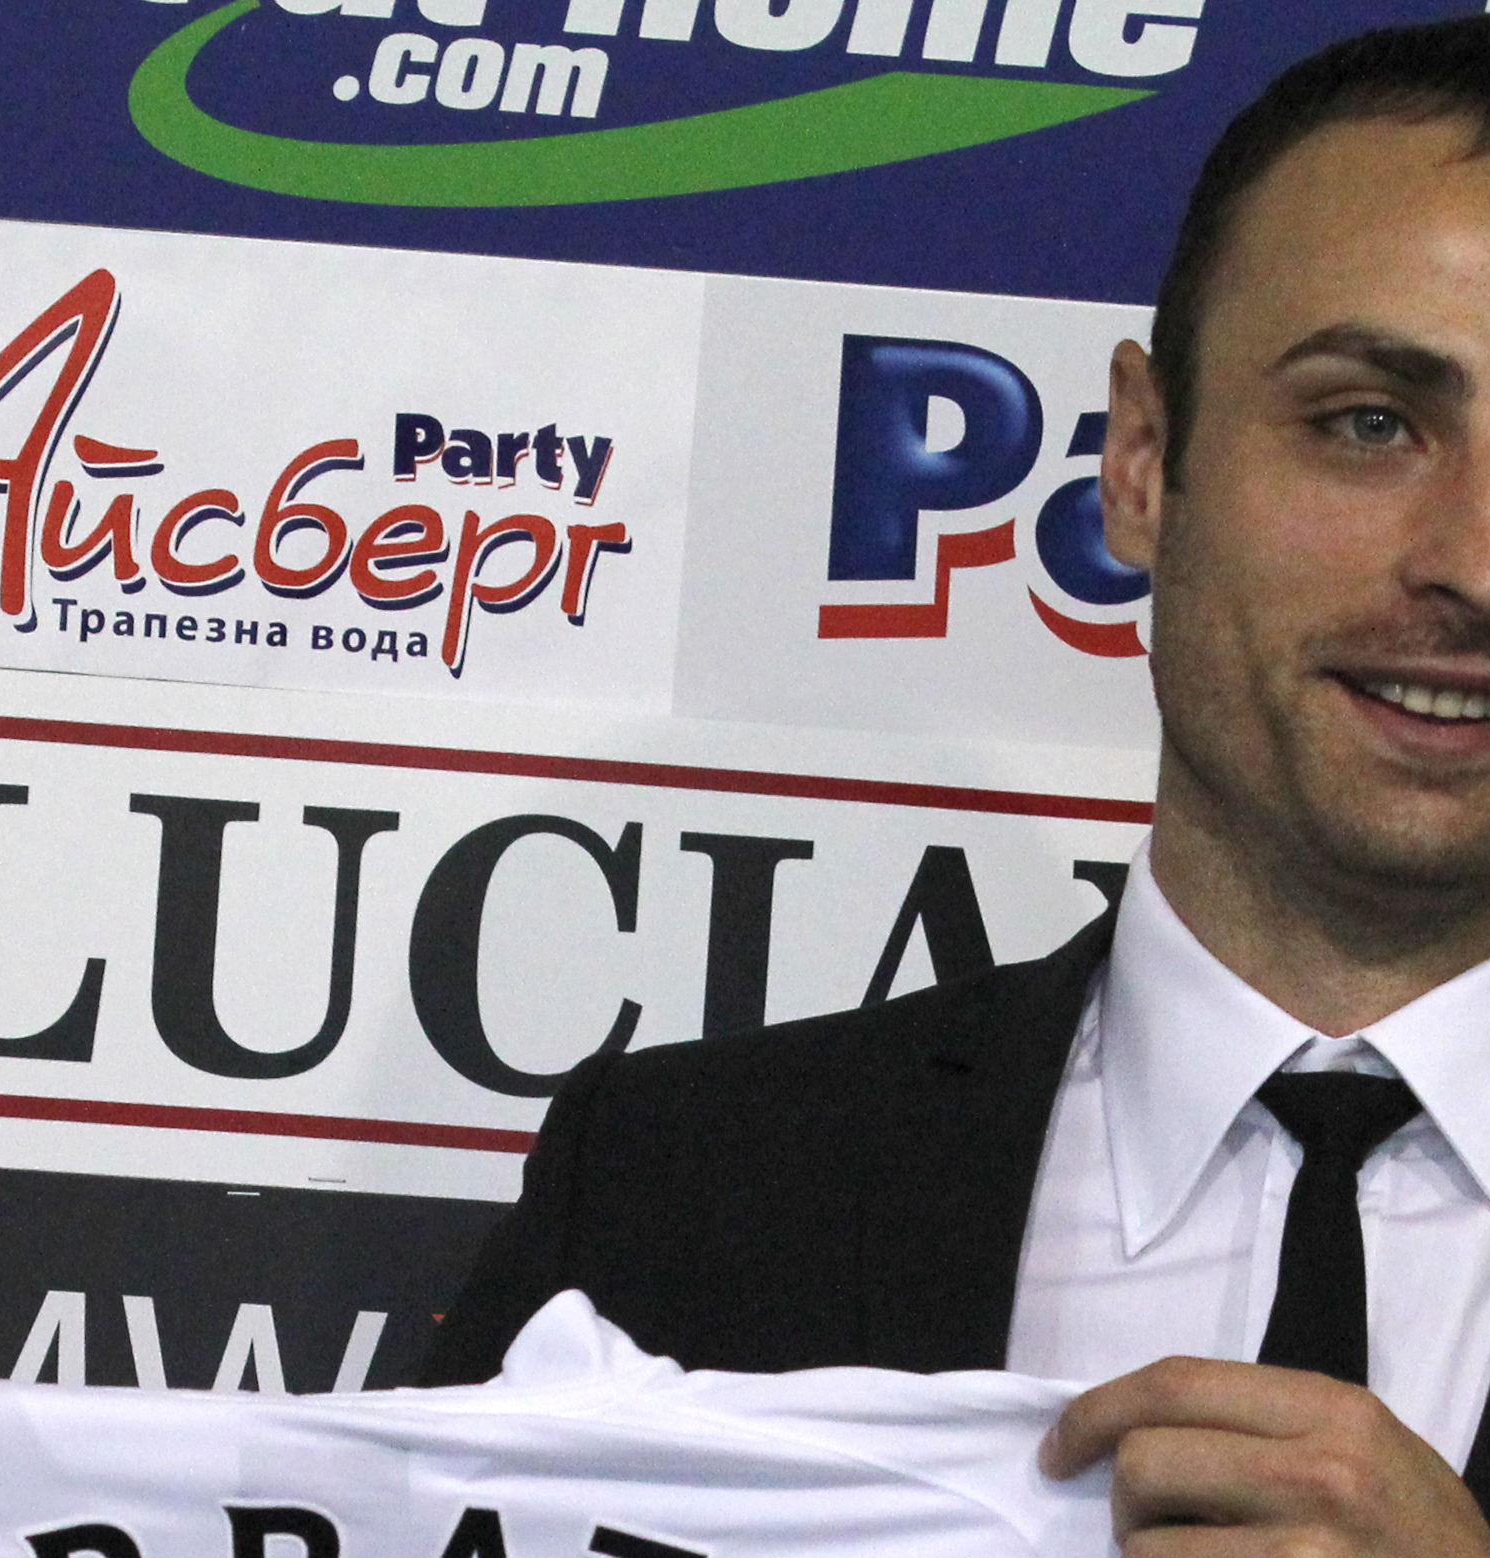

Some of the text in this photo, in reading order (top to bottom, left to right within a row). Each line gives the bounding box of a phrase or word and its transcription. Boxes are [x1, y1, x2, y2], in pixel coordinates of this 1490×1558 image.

[333, 33, 607, 118] .com
[393, 412, 615, 505] Party
[51, 598, 430, 663] Трапезна вода
